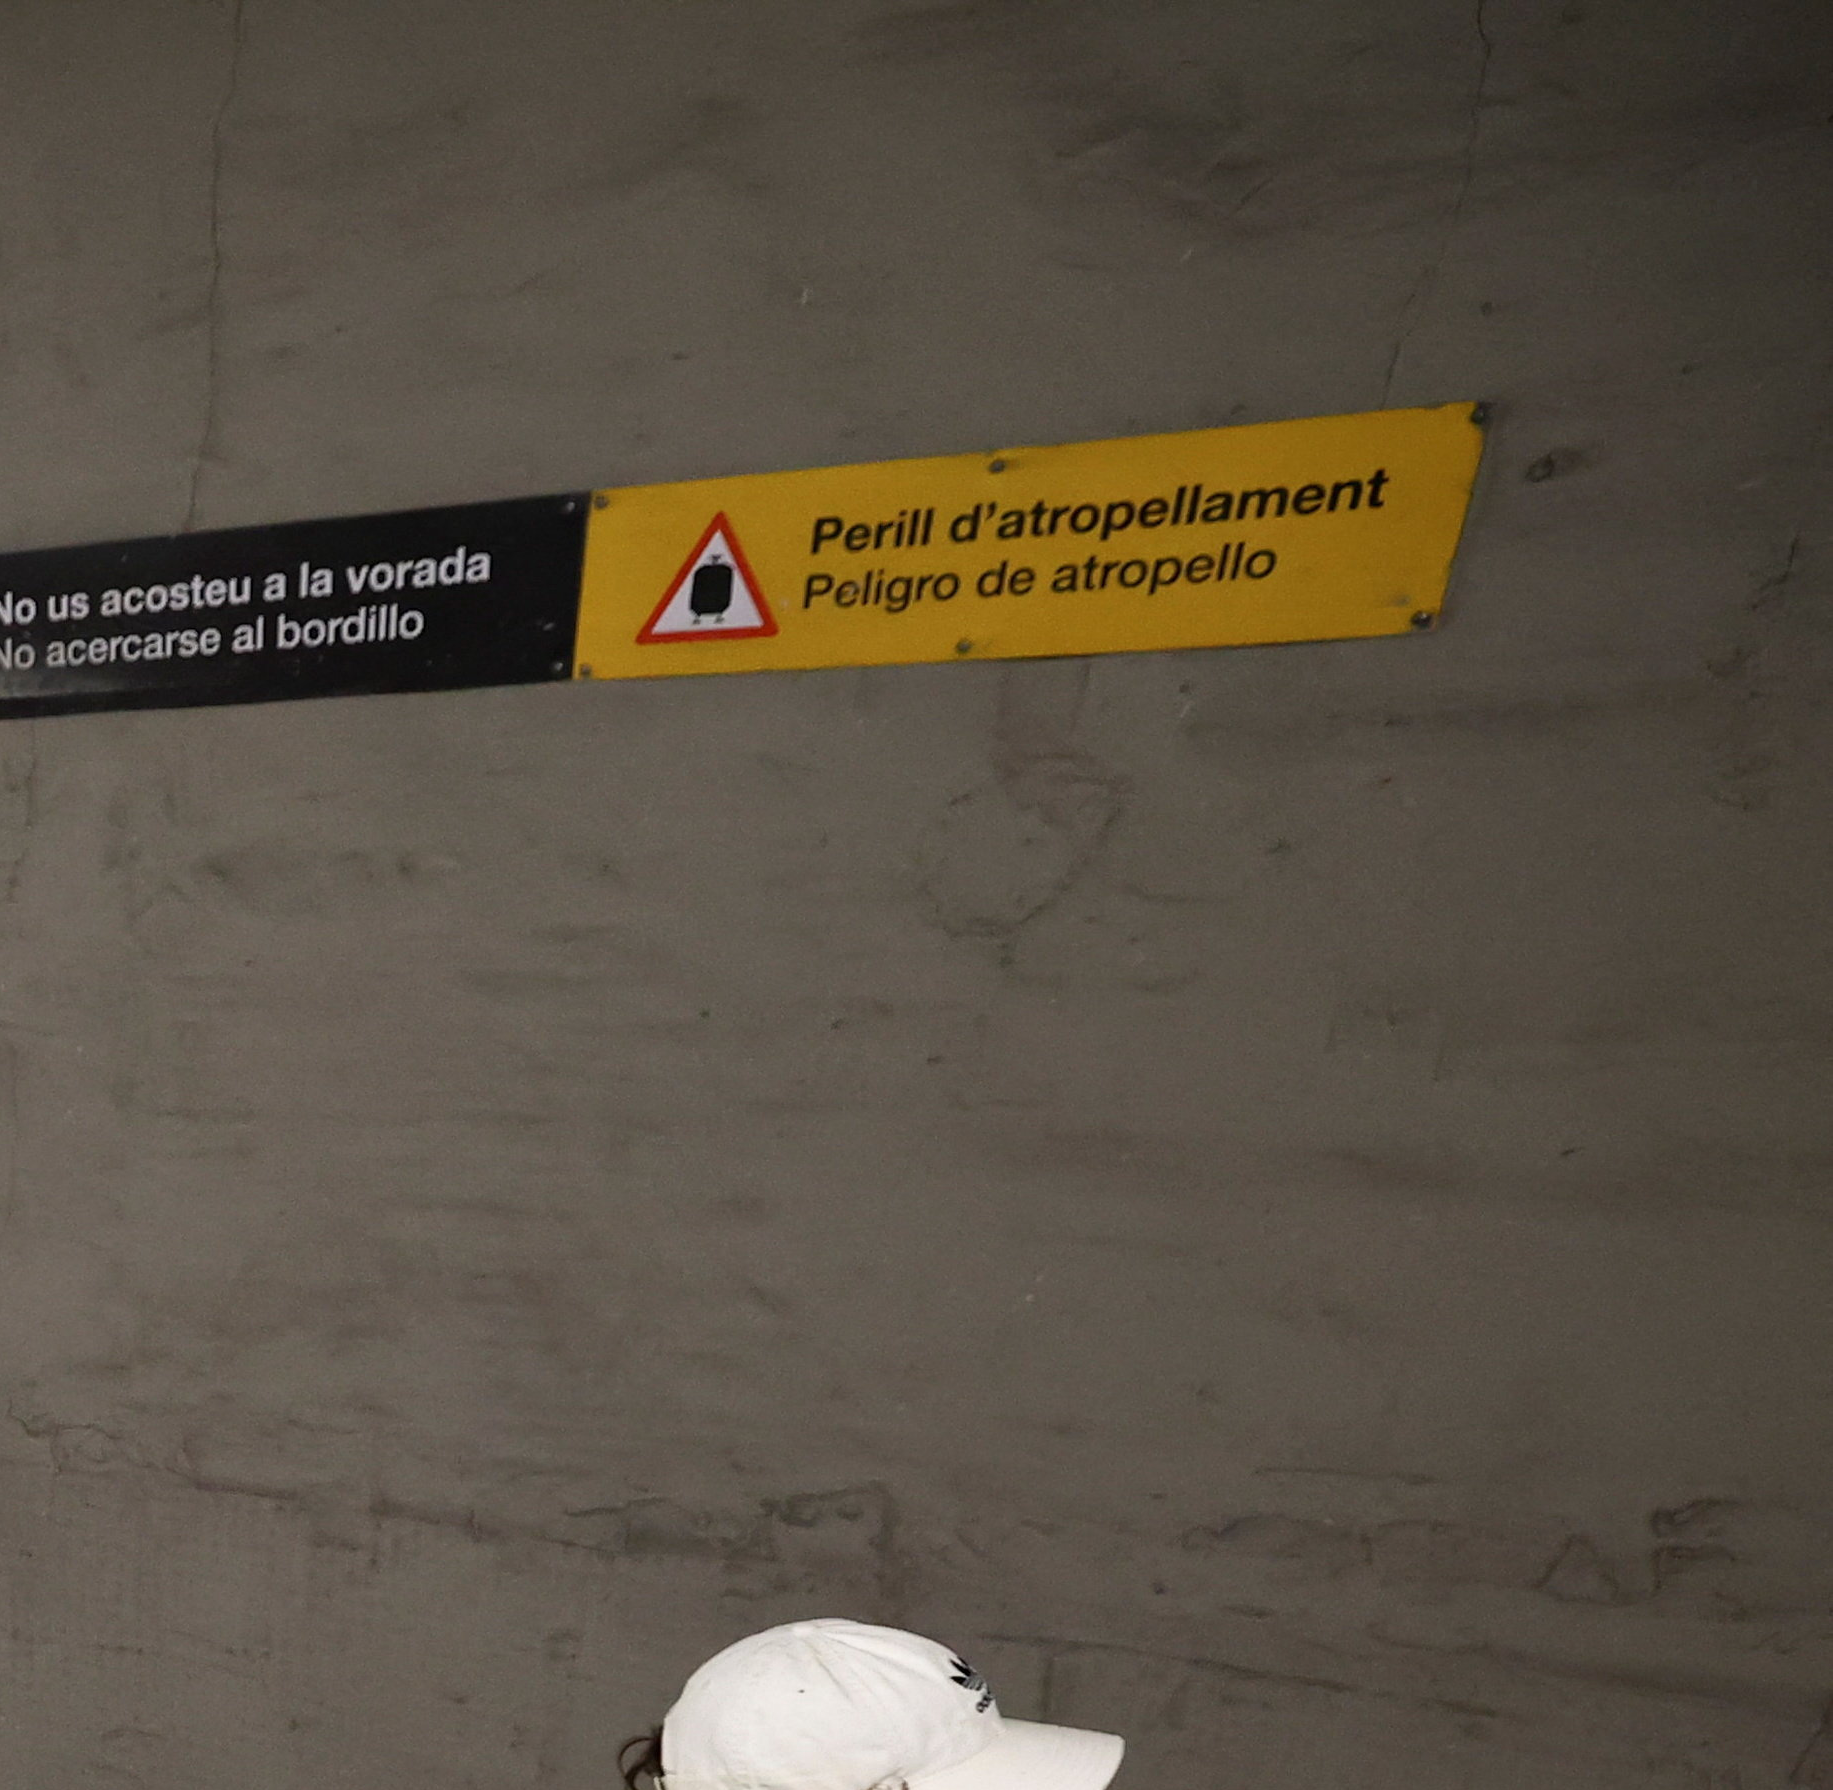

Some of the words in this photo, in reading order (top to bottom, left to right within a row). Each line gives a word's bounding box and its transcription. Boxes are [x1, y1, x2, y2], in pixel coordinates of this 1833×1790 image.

[810, 509, 935, 556] Perill
[949, 467, 1390, 546] d'atropellament
[48, 594, 90, 622] us
[100, 574, 252, 617] acosteu
[264, 574, 288, 602] a
[299, 561, 334, 599] la
[347, 547, 492, 594] vorada
[802, 569, 961, 615] Peligro
[976, 559, 1036, 600] de
[1051, 541, 1278, 602] atropello
[46, 627, 221, 669] acercarse
[233, 615, 266, 653] al
[277, 604, 425, 650] bordillo
